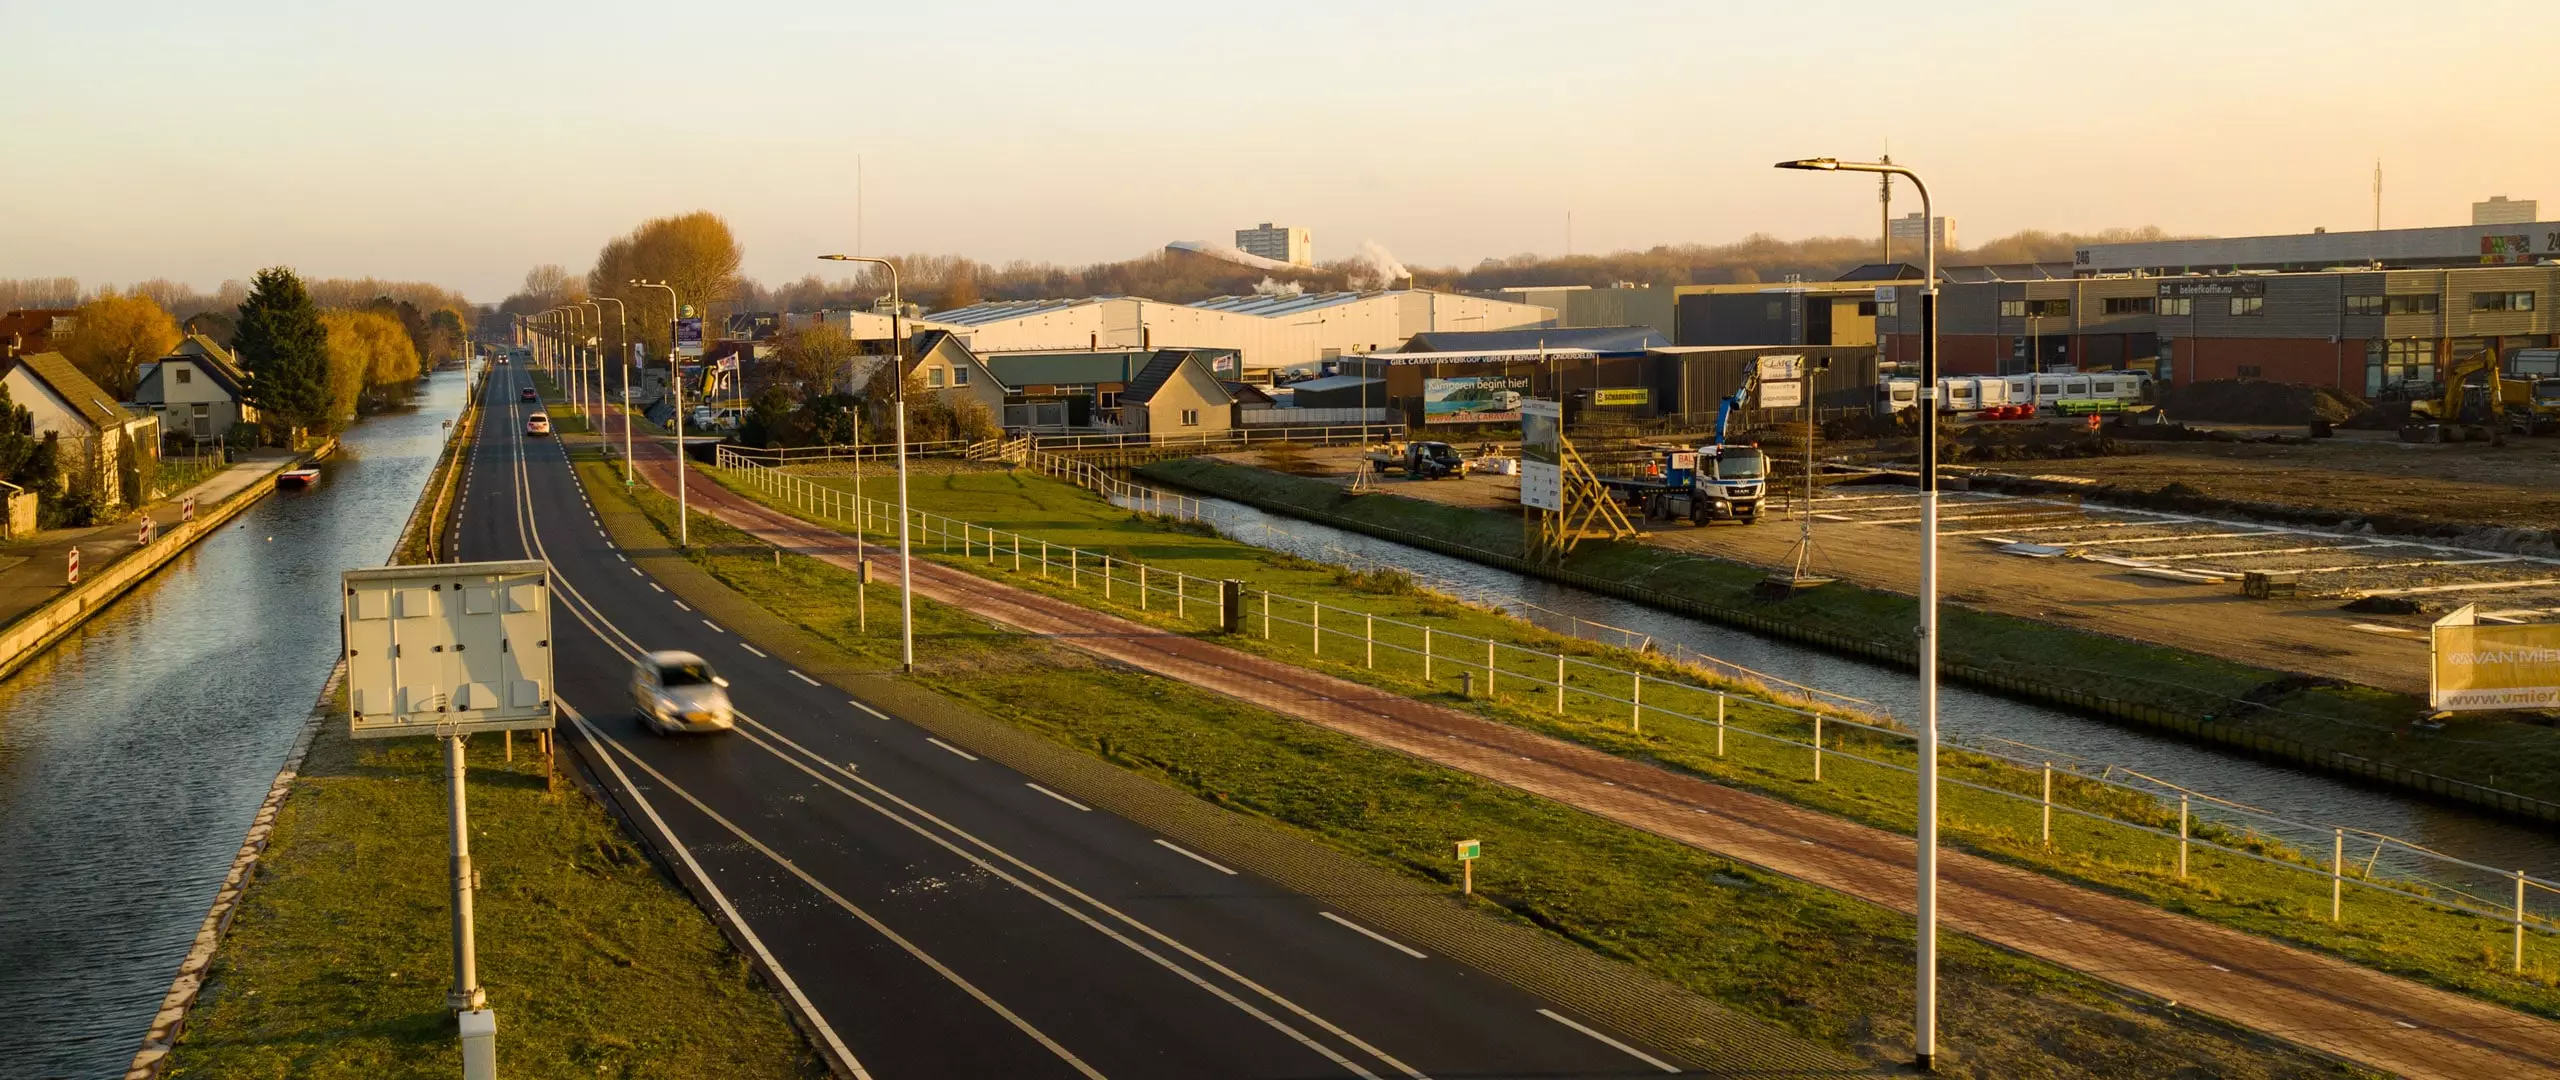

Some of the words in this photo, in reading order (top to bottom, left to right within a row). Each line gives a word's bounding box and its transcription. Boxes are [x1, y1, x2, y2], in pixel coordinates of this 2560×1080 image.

[1390, 358, 1406, 366] GIEL
[1428, 381, 1475, 391] Kamperen
[1477, 377, 1507, 391] begint
[1508, 377, 1528, 388] hier!
